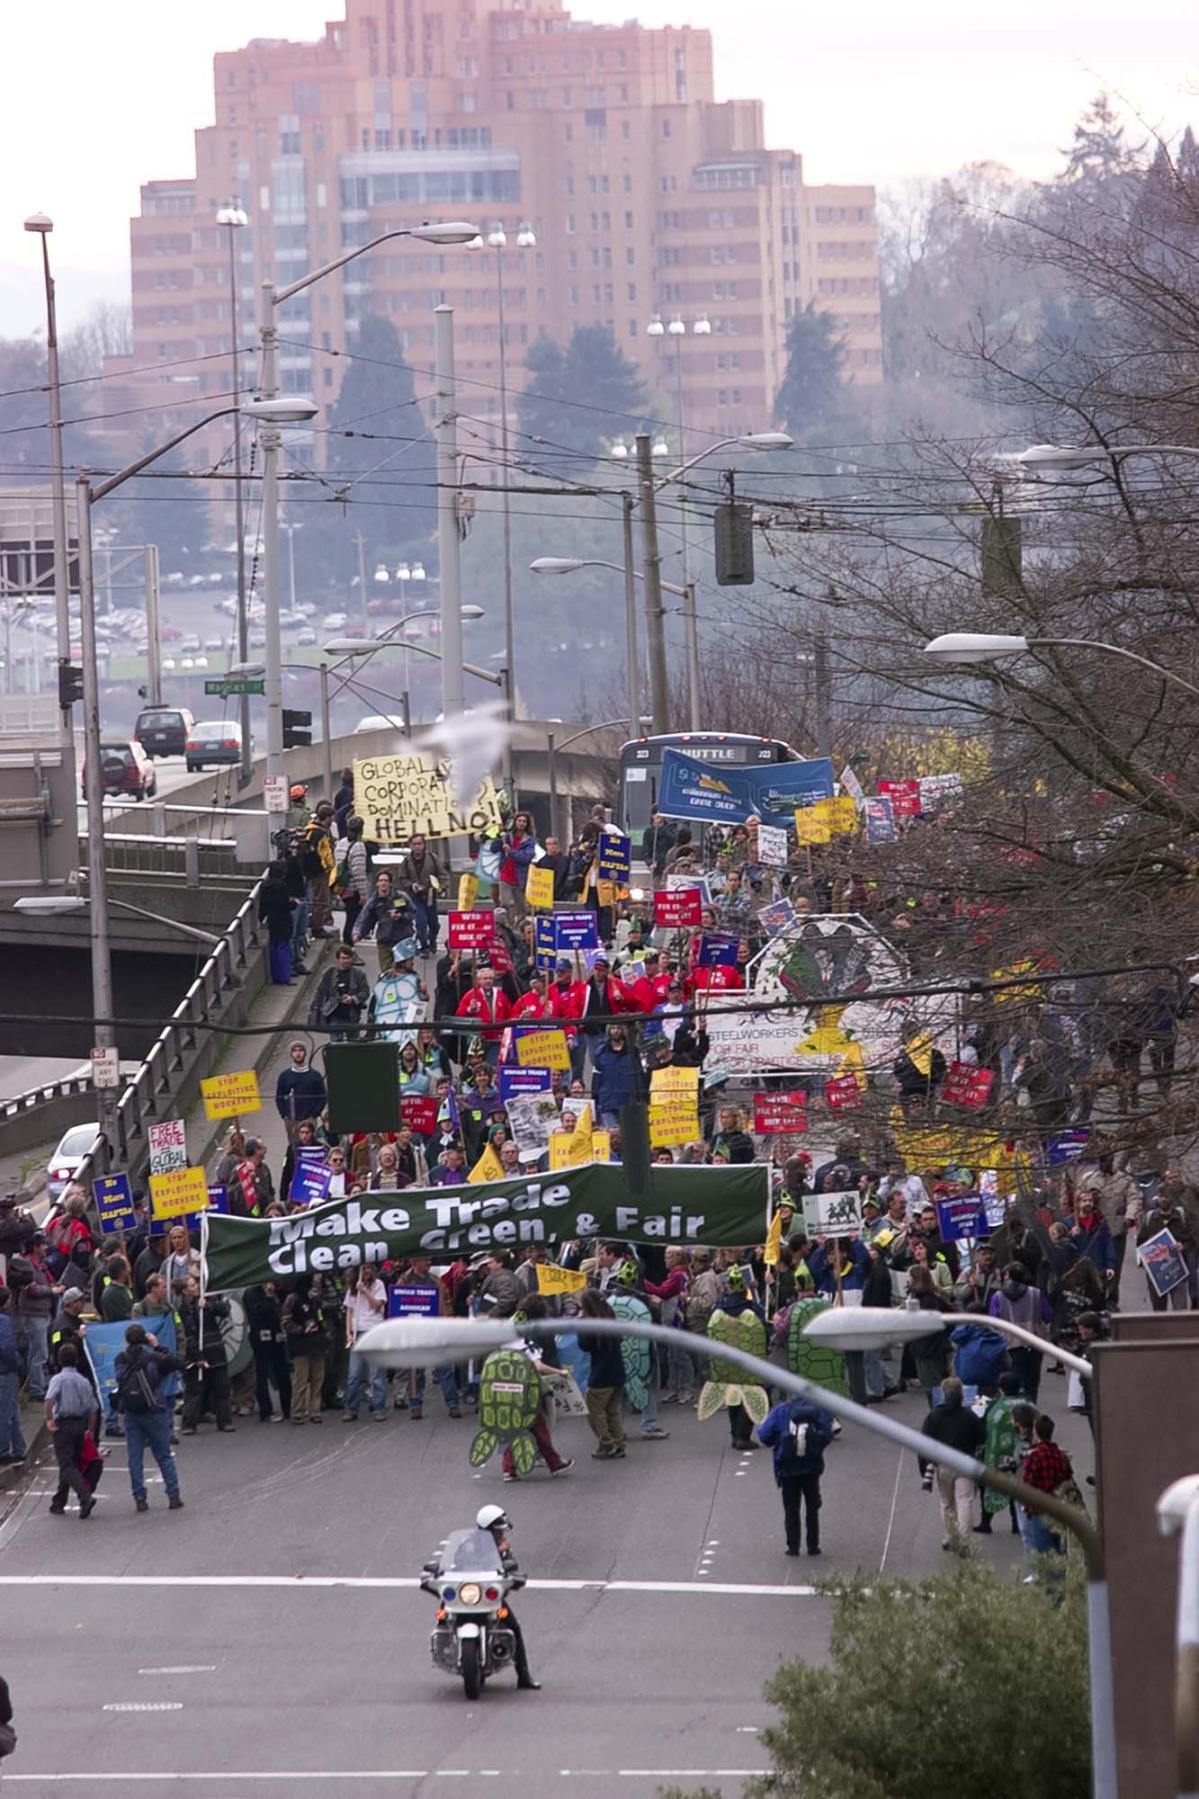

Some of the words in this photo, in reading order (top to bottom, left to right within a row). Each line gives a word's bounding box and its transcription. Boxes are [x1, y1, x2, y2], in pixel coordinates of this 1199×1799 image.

[680, 749, 735, 759] HUTTLE
[361, 757, 436, 780] GLOBAL
[375, 818, 441, 839] HELL
[448, 801, 496, 832] NO!
[709, 1028, 798, 1041] STEELWORKERS
[218, 1077, 238, 1086] STOP
[208, 1085, 255, 1098] EXPLOITING
[151, 1121, 180, 1139] FREE
[151, 1133, 184, 1149] TRADE
[167, 1173, 187, 1183] STOP
[155, 1182, 203, 1197] EXPLOITING
[162, 1194, 201, 1208] WORKERS
[269, 1202, 410, 1245] Make
[426, 1184, 571, 1227] Trade
[268, 1239, 388, 1275] Clean
[420, 1217, 557, 1250] Green,
[576, 1213, 599, 1236] &
[616, 1206, 705, 1238] Fair
